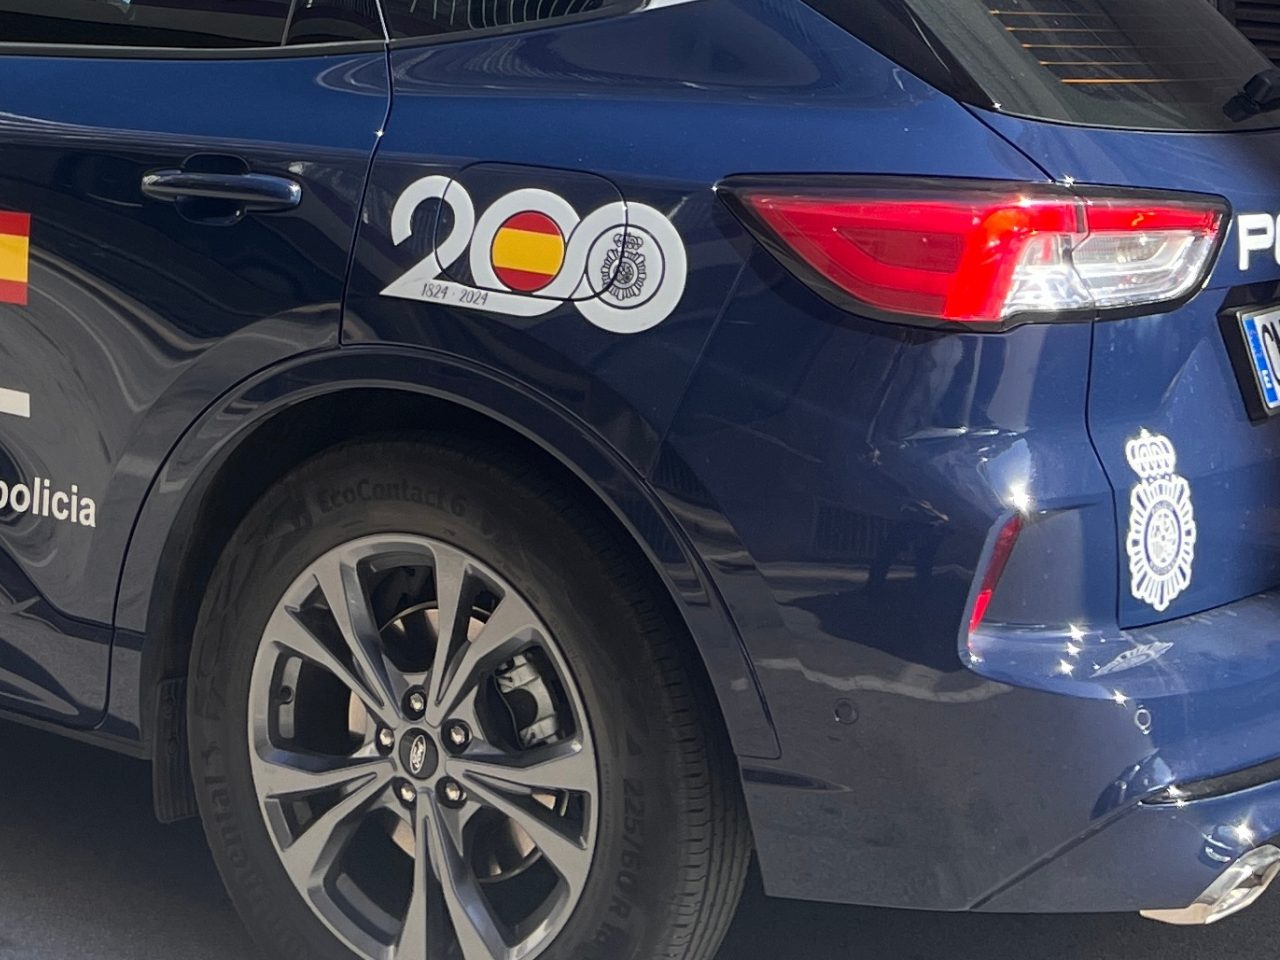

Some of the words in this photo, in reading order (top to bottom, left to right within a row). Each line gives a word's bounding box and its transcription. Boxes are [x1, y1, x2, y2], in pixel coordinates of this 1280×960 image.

[379, 175, 688, 334] 200
[1237, 213, 1280, 271] P
[421, 283, 448, 299] 1824
[459, 289, 489, 306] 2024
